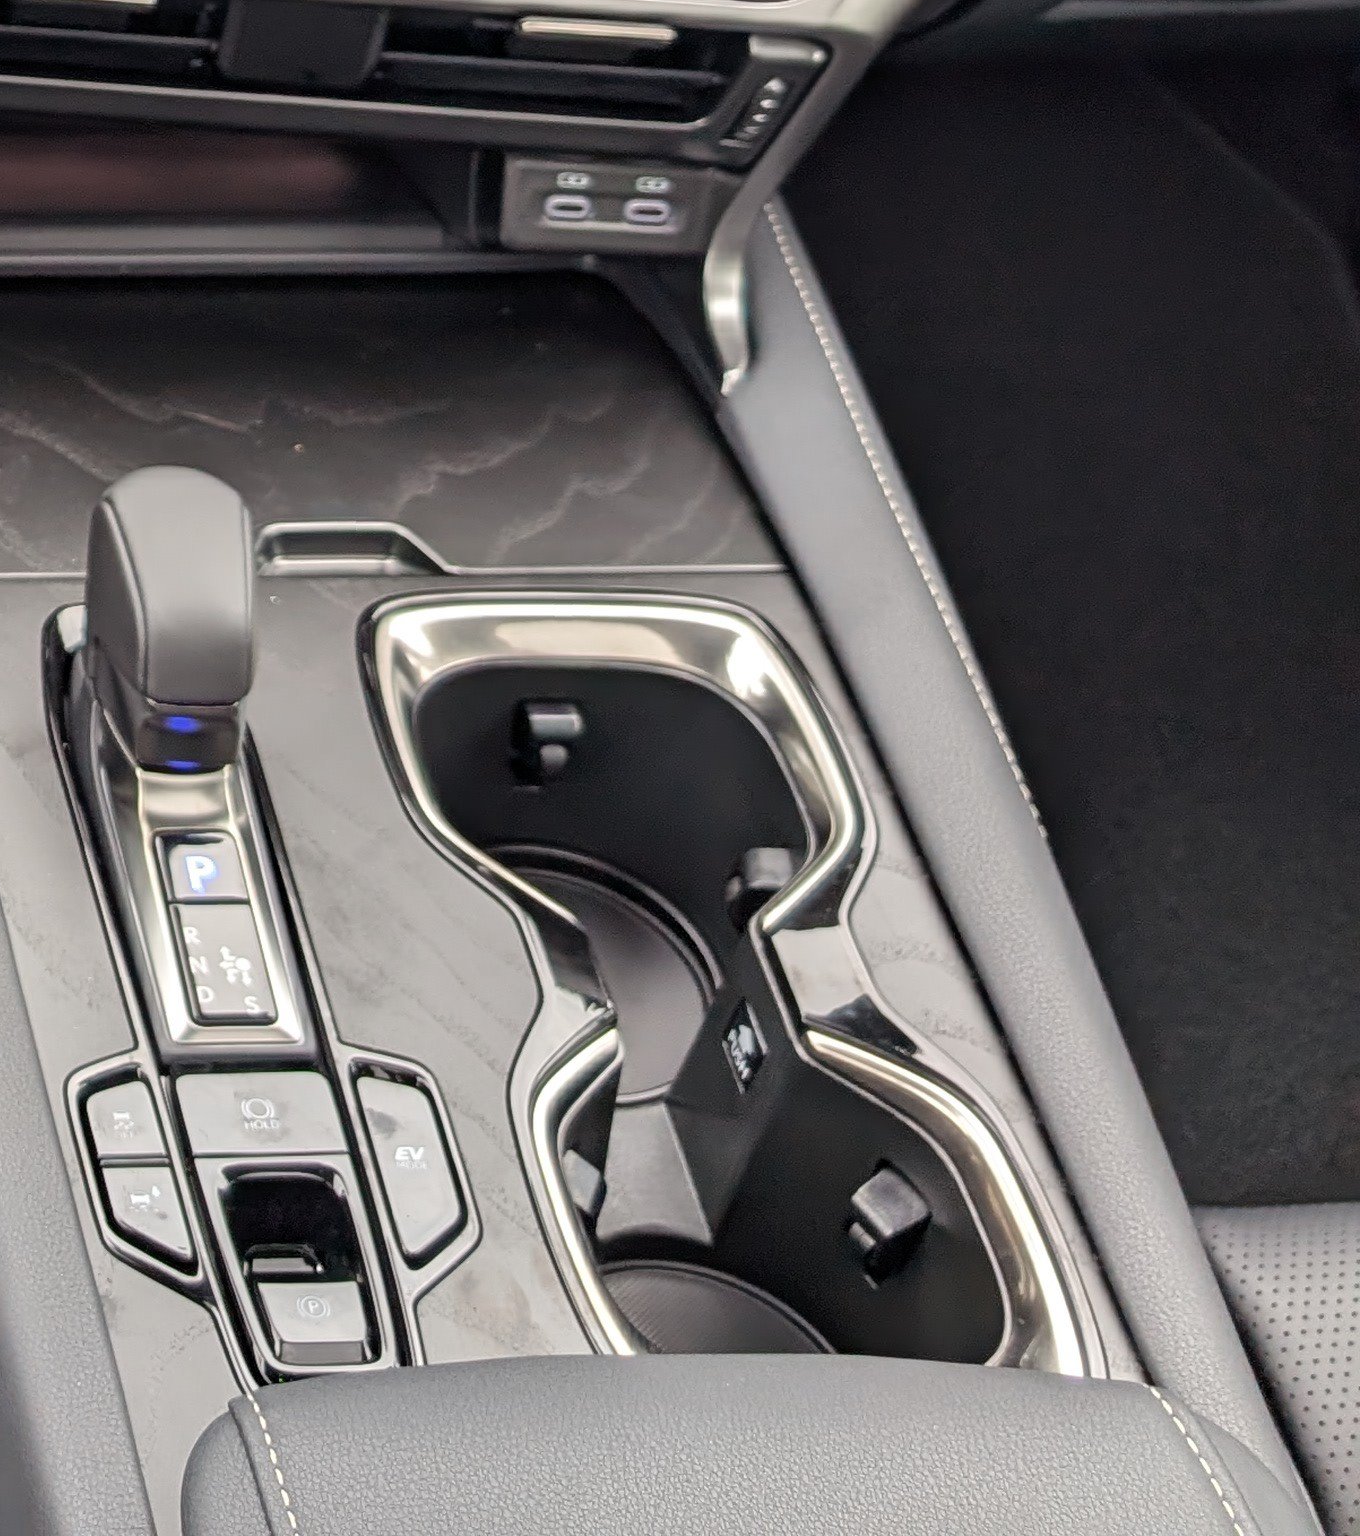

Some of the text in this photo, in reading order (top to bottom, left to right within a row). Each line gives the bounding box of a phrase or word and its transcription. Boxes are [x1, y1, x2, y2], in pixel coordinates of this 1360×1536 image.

[184, 855, 217, 894] P
[182, 926, 201, 945] R
[188, 955, 209, 975] N
[195, 985, 214, 1003] D
[243, 995, 261, 1013] S
[243, 1119, 280, 1131] HOLD
[394, 1146, 425, 1160] EV
